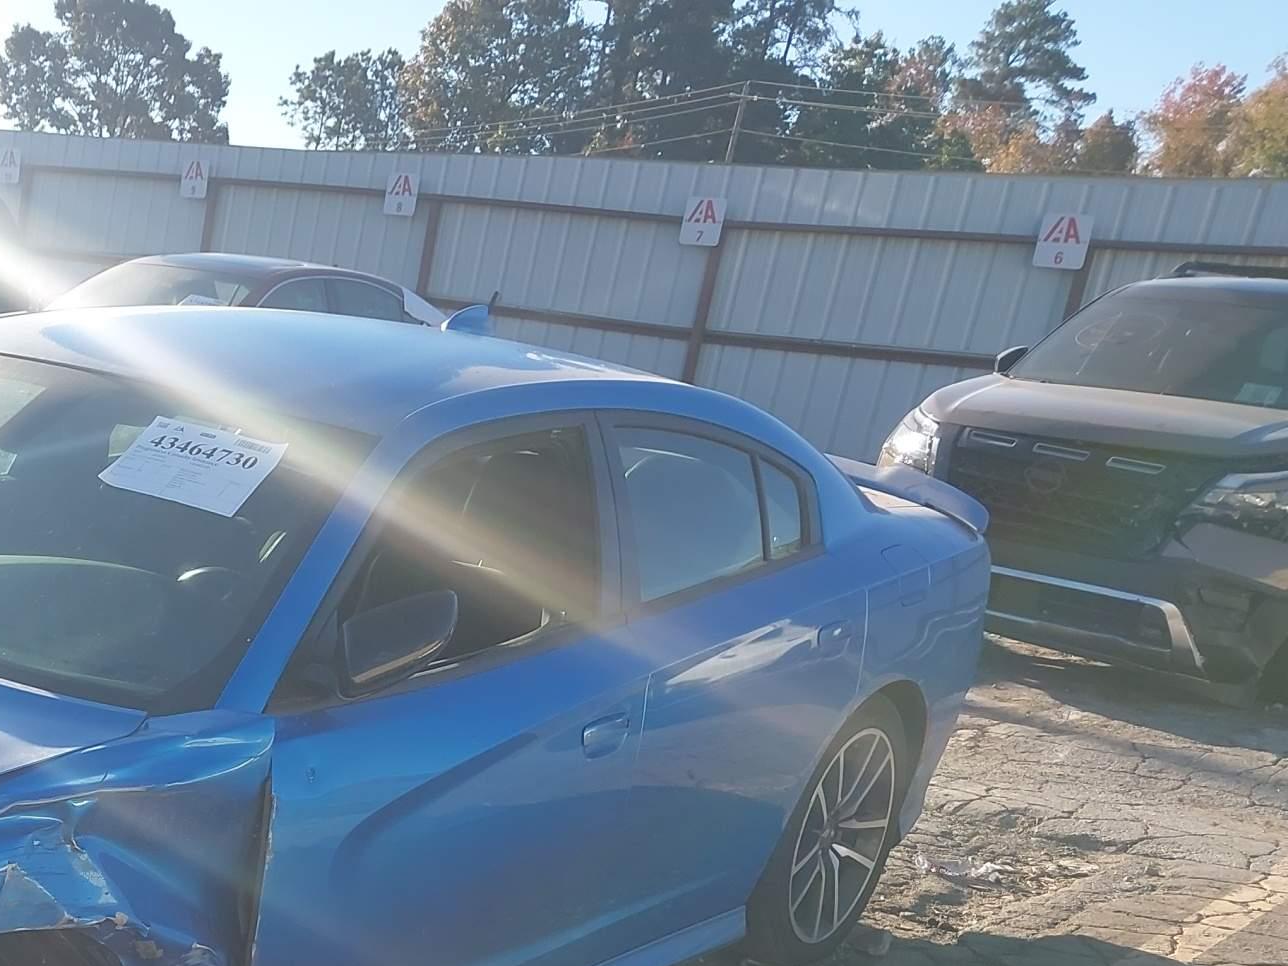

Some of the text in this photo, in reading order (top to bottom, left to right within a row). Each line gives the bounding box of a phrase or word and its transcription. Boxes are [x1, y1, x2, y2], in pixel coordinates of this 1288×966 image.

[695, 230, 704, 242] 7
[1054, 251, 1064, 264] 6
[150, 434, 259, 470] 43464730
